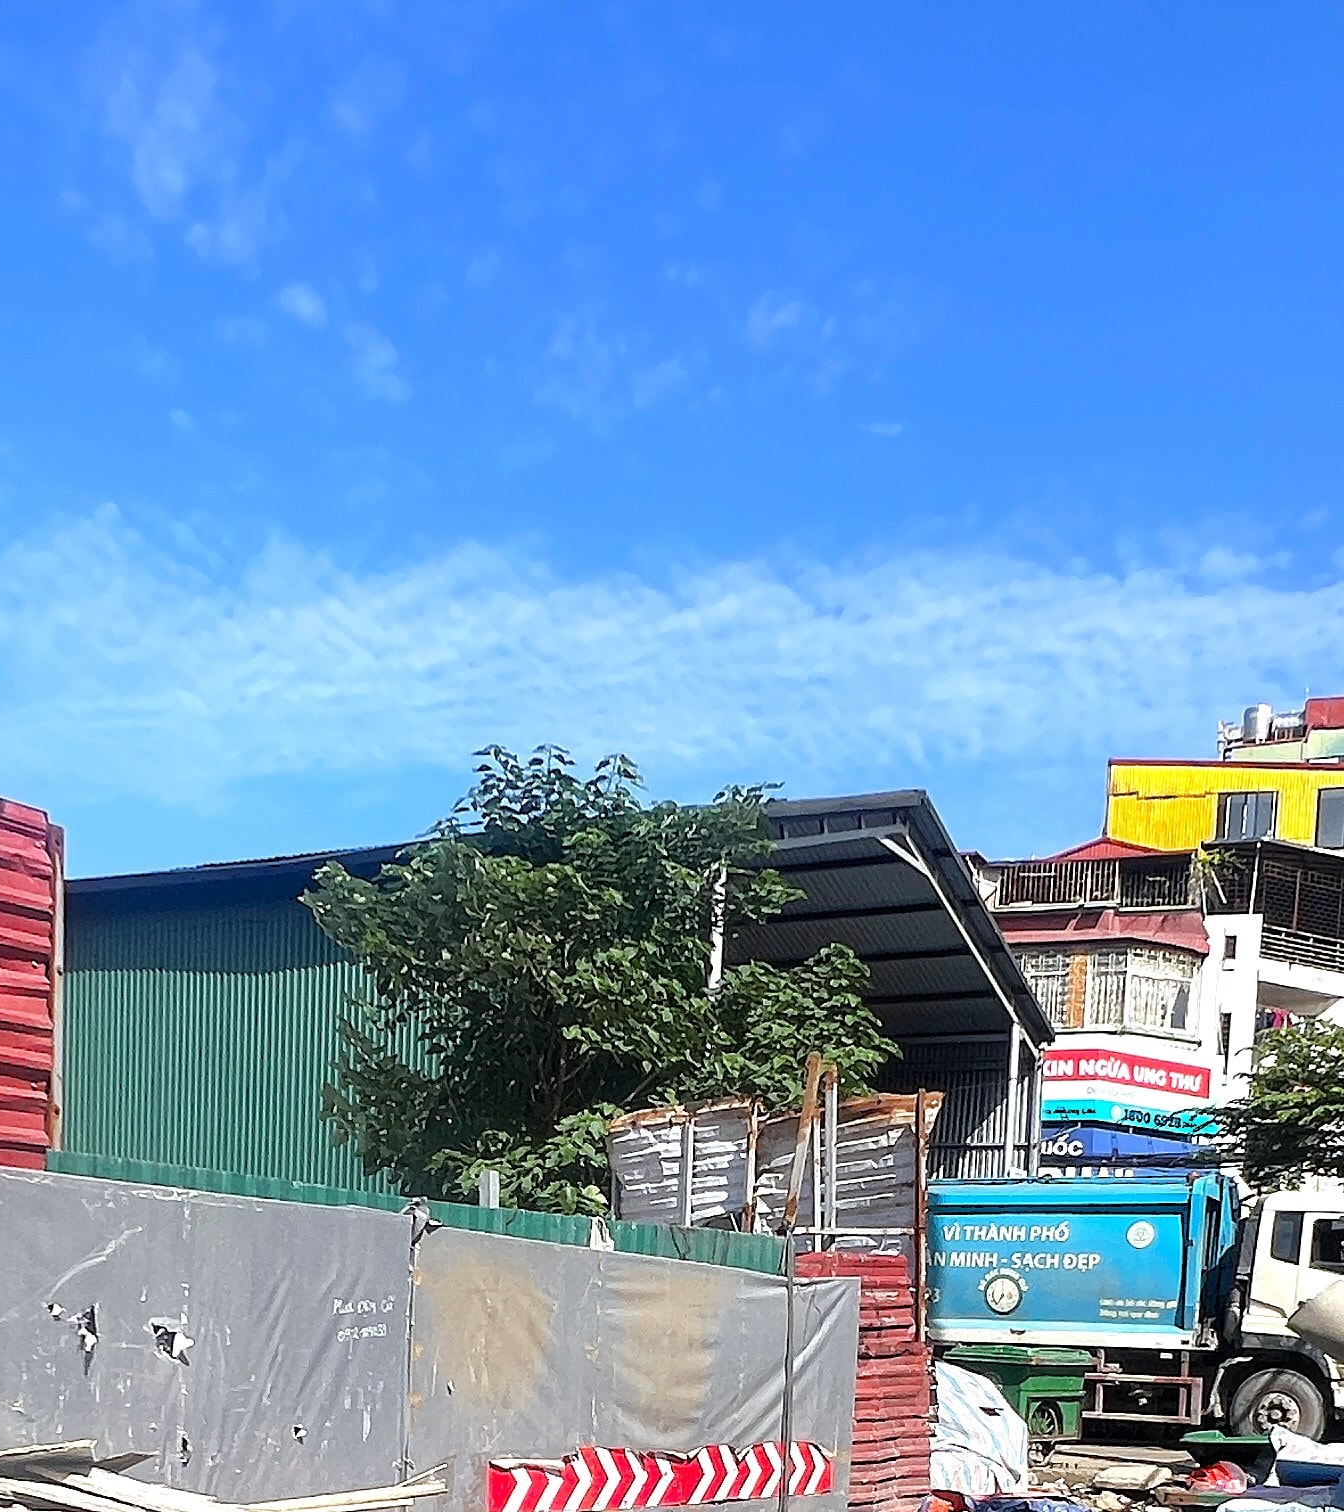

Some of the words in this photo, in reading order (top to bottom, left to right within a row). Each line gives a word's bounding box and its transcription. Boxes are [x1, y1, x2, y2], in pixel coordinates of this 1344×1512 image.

[1078, 1056, 1130, 1080] NGỪA
[1133, 1065, 1167, 1087] UNG
[1168, 1071, 1203, 1093] THƯ
[943, 1221, 961, 1241] VÌ
[963, 1222, 1026, 1242] THÀNH
[1029, 1220, 1070, 1242] PHỐ
[949, 1251, 998, 1268] MINH
[1011, 1252, 1059, 1272] SẠCH
[1062, 1253, 1101, 1273] ĐẸP
